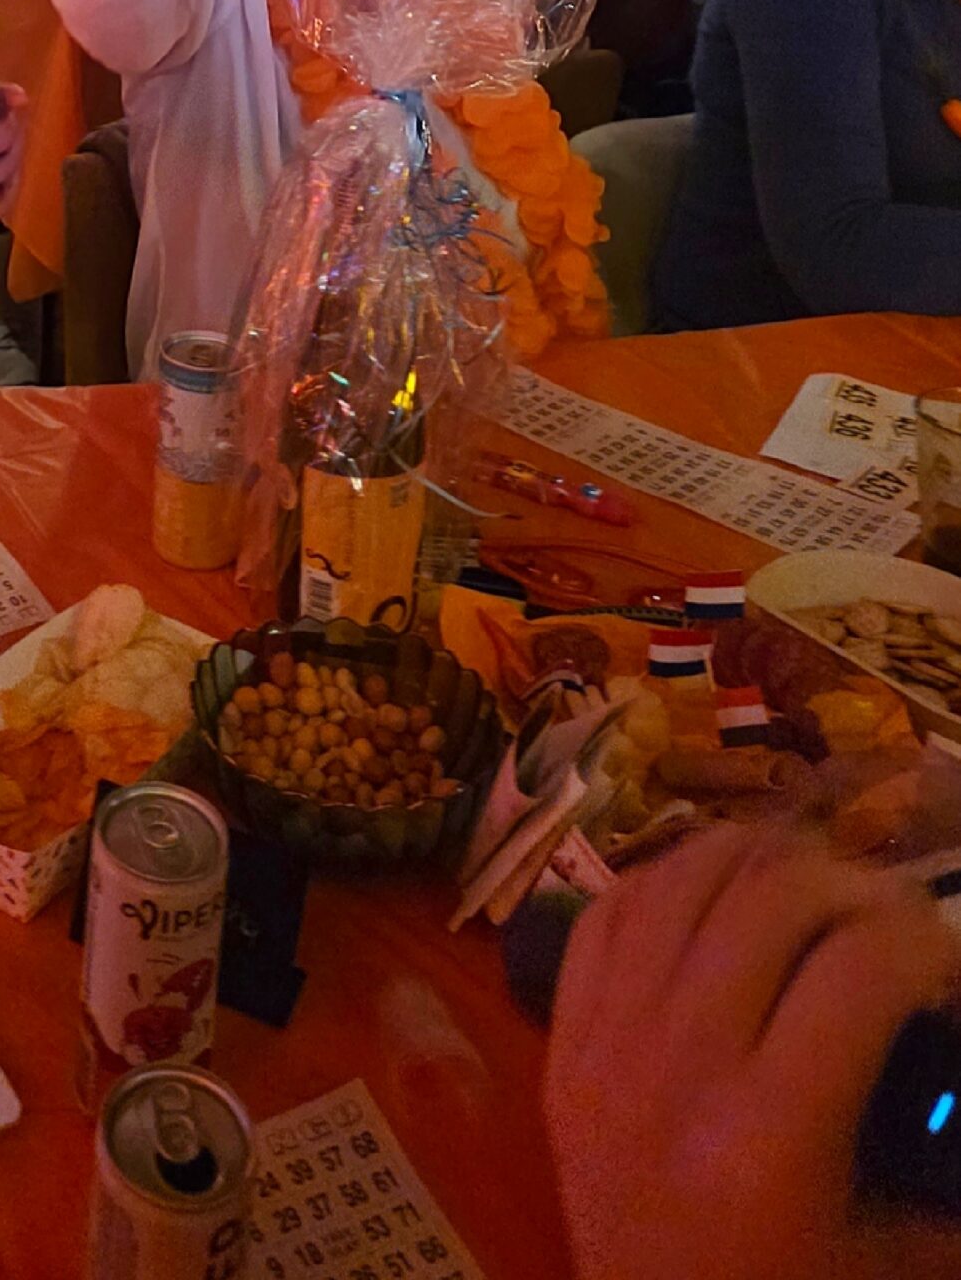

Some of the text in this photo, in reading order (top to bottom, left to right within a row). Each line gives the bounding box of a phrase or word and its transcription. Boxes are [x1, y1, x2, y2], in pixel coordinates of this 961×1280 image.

[835, 413, 875, 440] 436
[858, 470, 910, 500] 433
[3, 581, 13, 590] 5
[10, 596, 27, 606] 10
[286, 1158, 314, 1185] 39
[318, 1145, 344, 1172] 57
[350, 1130, 380, 1159] 68
[273, 1206, 302, 1234] 29
[305, 1192, 333, 1220] 37
[372, 1167, 400, 1193] 61
[361, 1215, 390, 1241] 53
[392, 1199, 421, 1227] 71
[383, 1250, 413, 1278] 51
